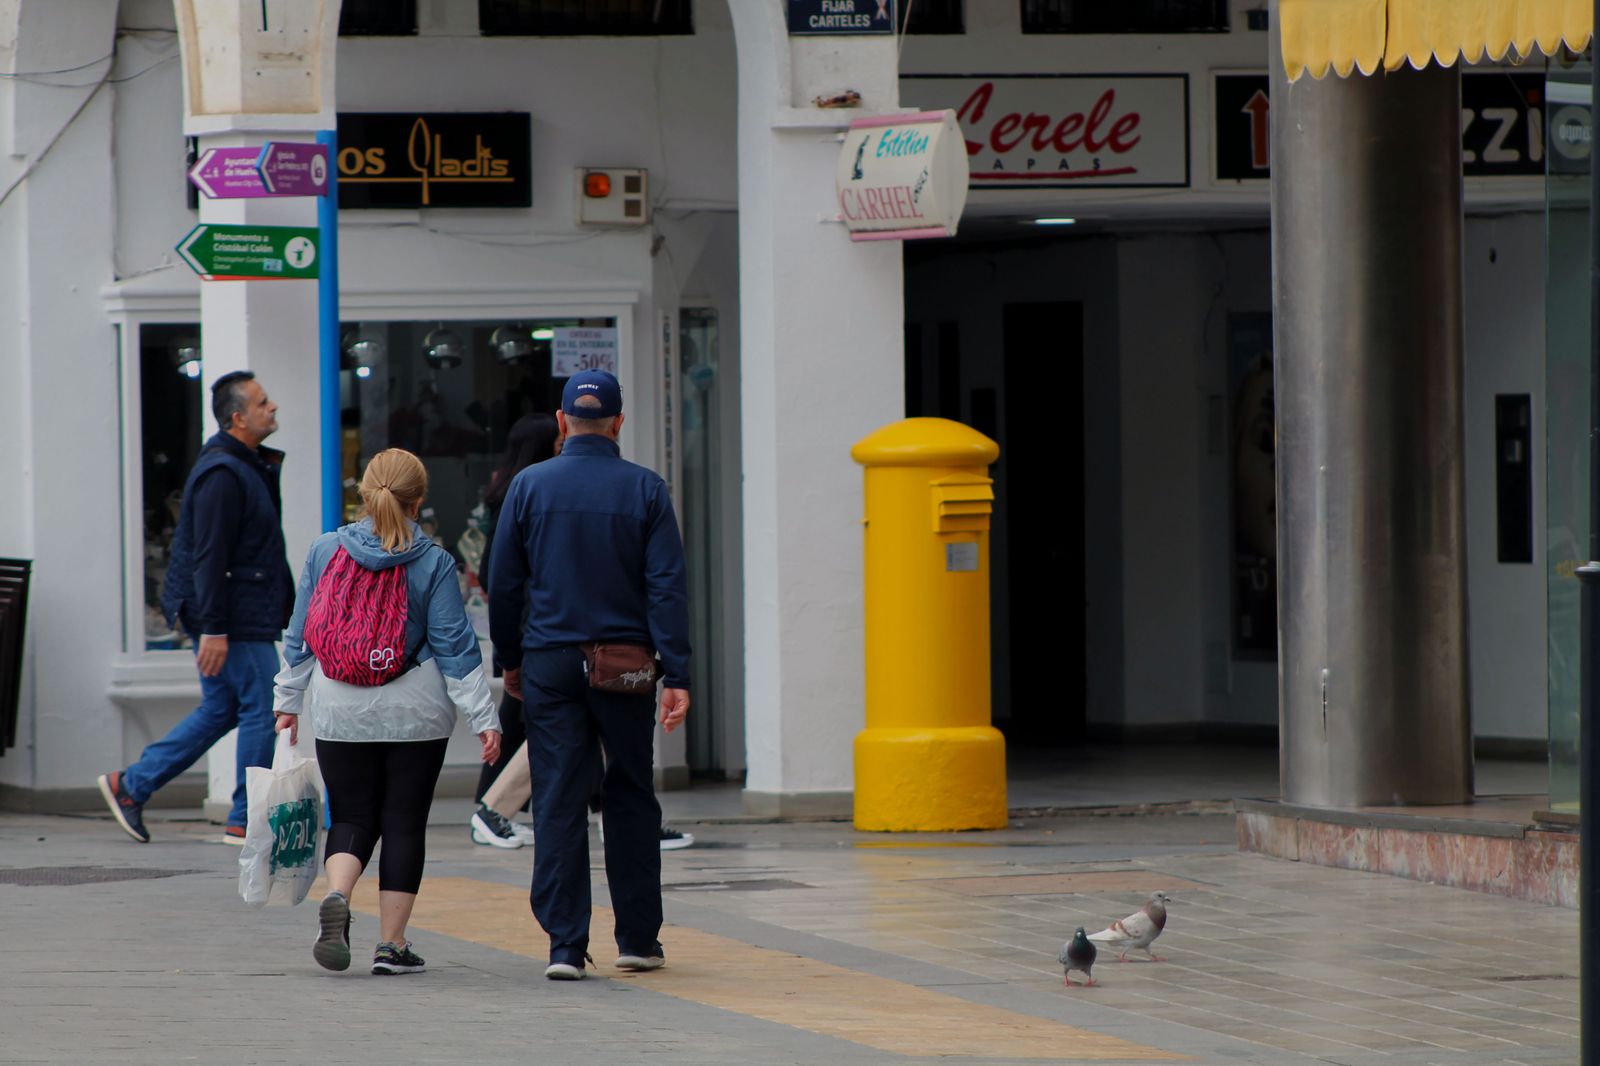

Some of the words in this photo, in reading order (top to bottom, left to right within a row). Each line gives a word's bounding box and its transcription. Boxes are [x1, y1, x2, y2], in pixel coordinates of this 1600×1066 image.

[821, 0, 855, 12] FIJAR
[809, 15, 871, 28] CARTELES
[993, 158, 1101, 171] APAS
[841, 186, 924, 221] CARHEL
[213, 232, 262, 242] Monumento
